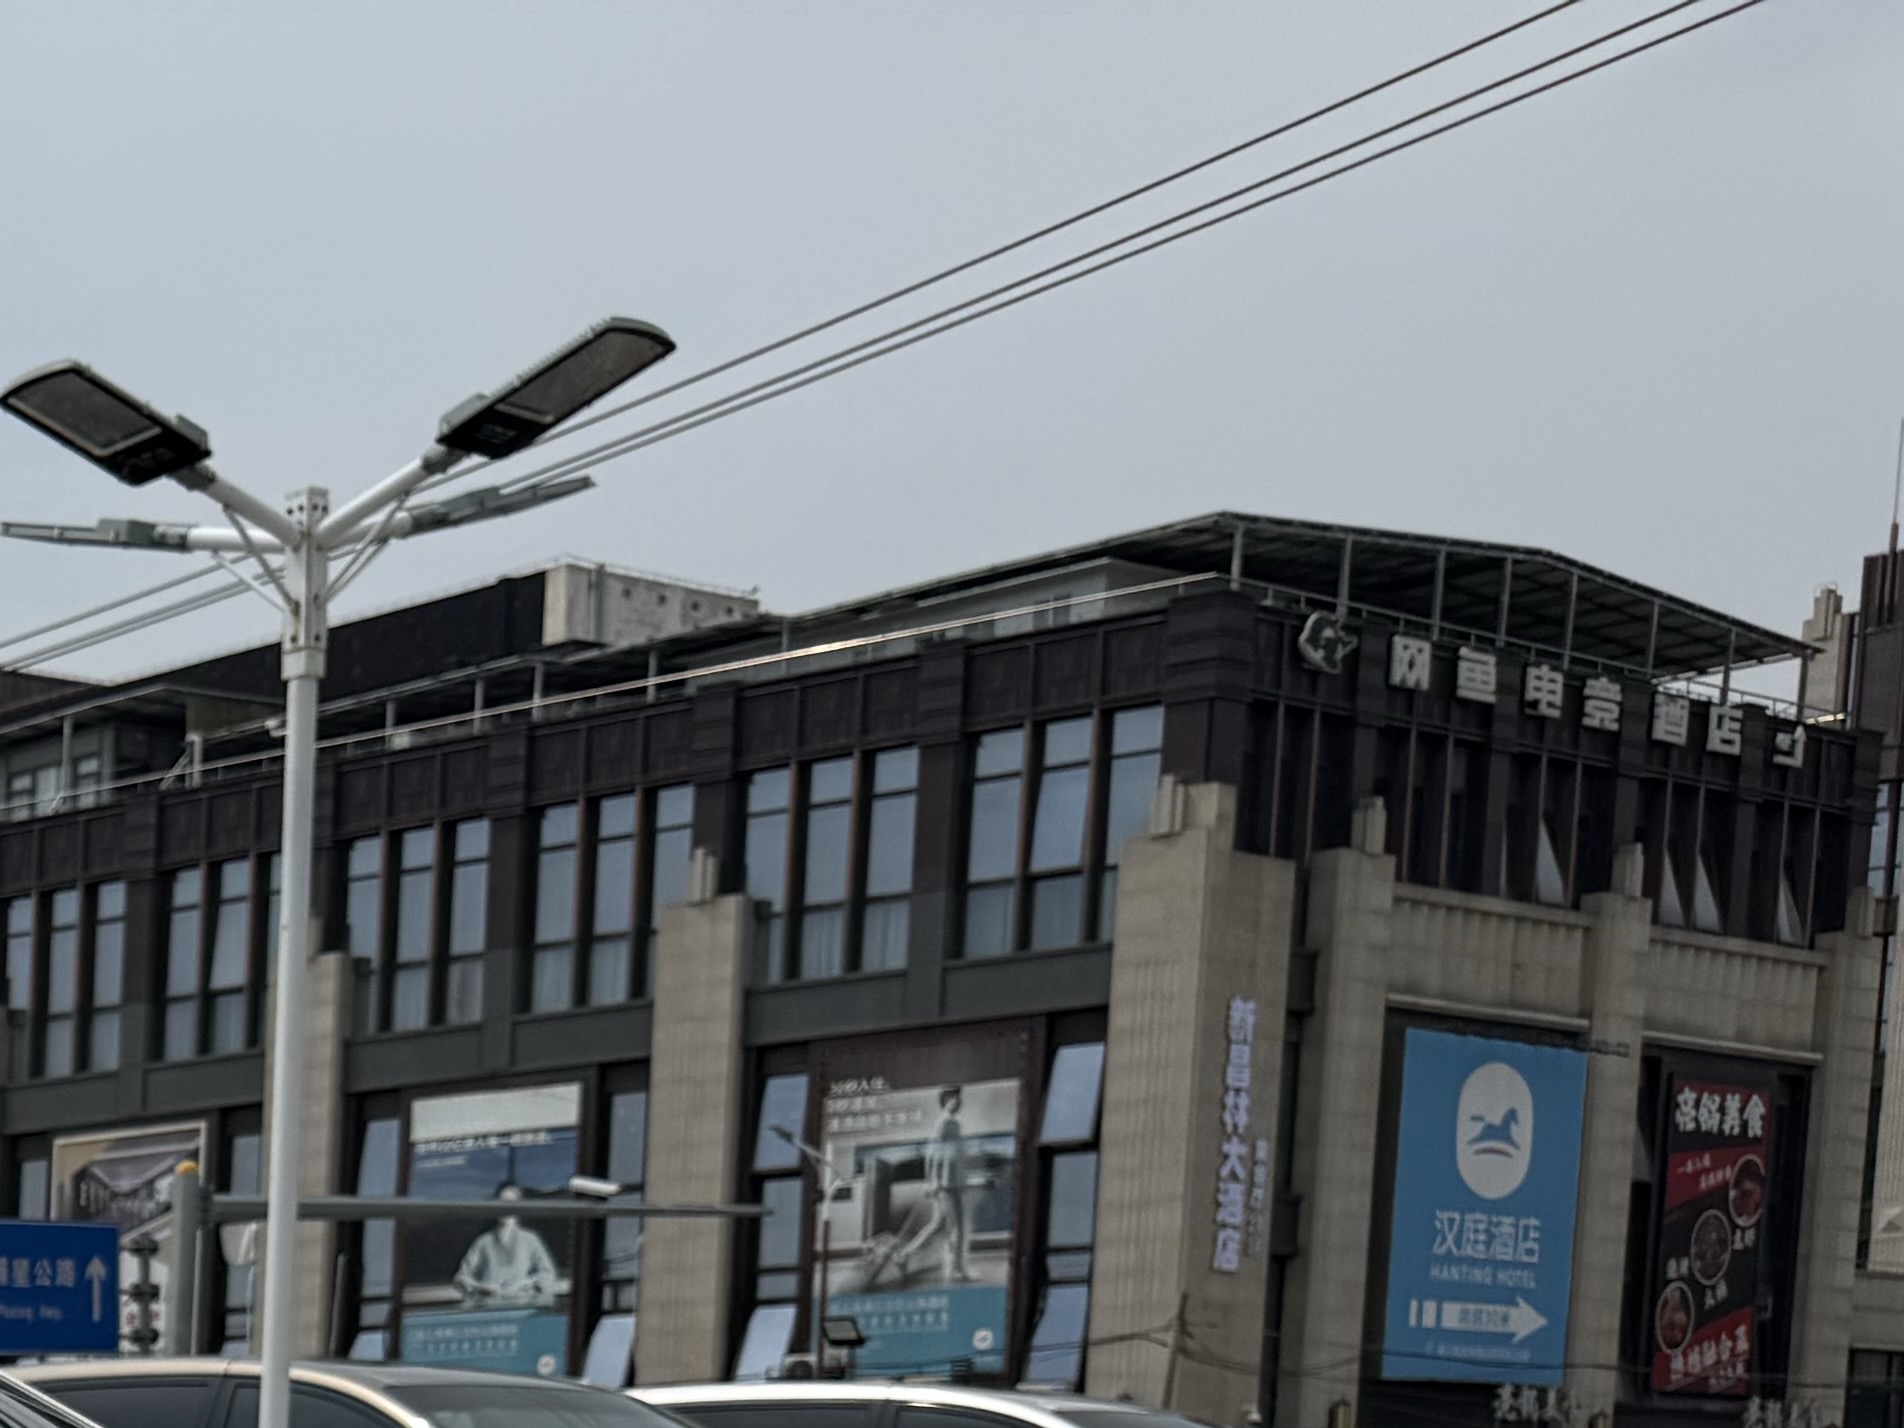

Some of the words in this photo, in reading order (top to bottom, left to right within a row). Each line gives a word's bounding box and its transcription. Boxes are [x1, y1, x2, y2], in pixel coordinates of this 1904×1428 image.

[1432, 1208, 1541, 1264] 汉庭酒店
[1429, 1261, 1493, 1286] HANTING
